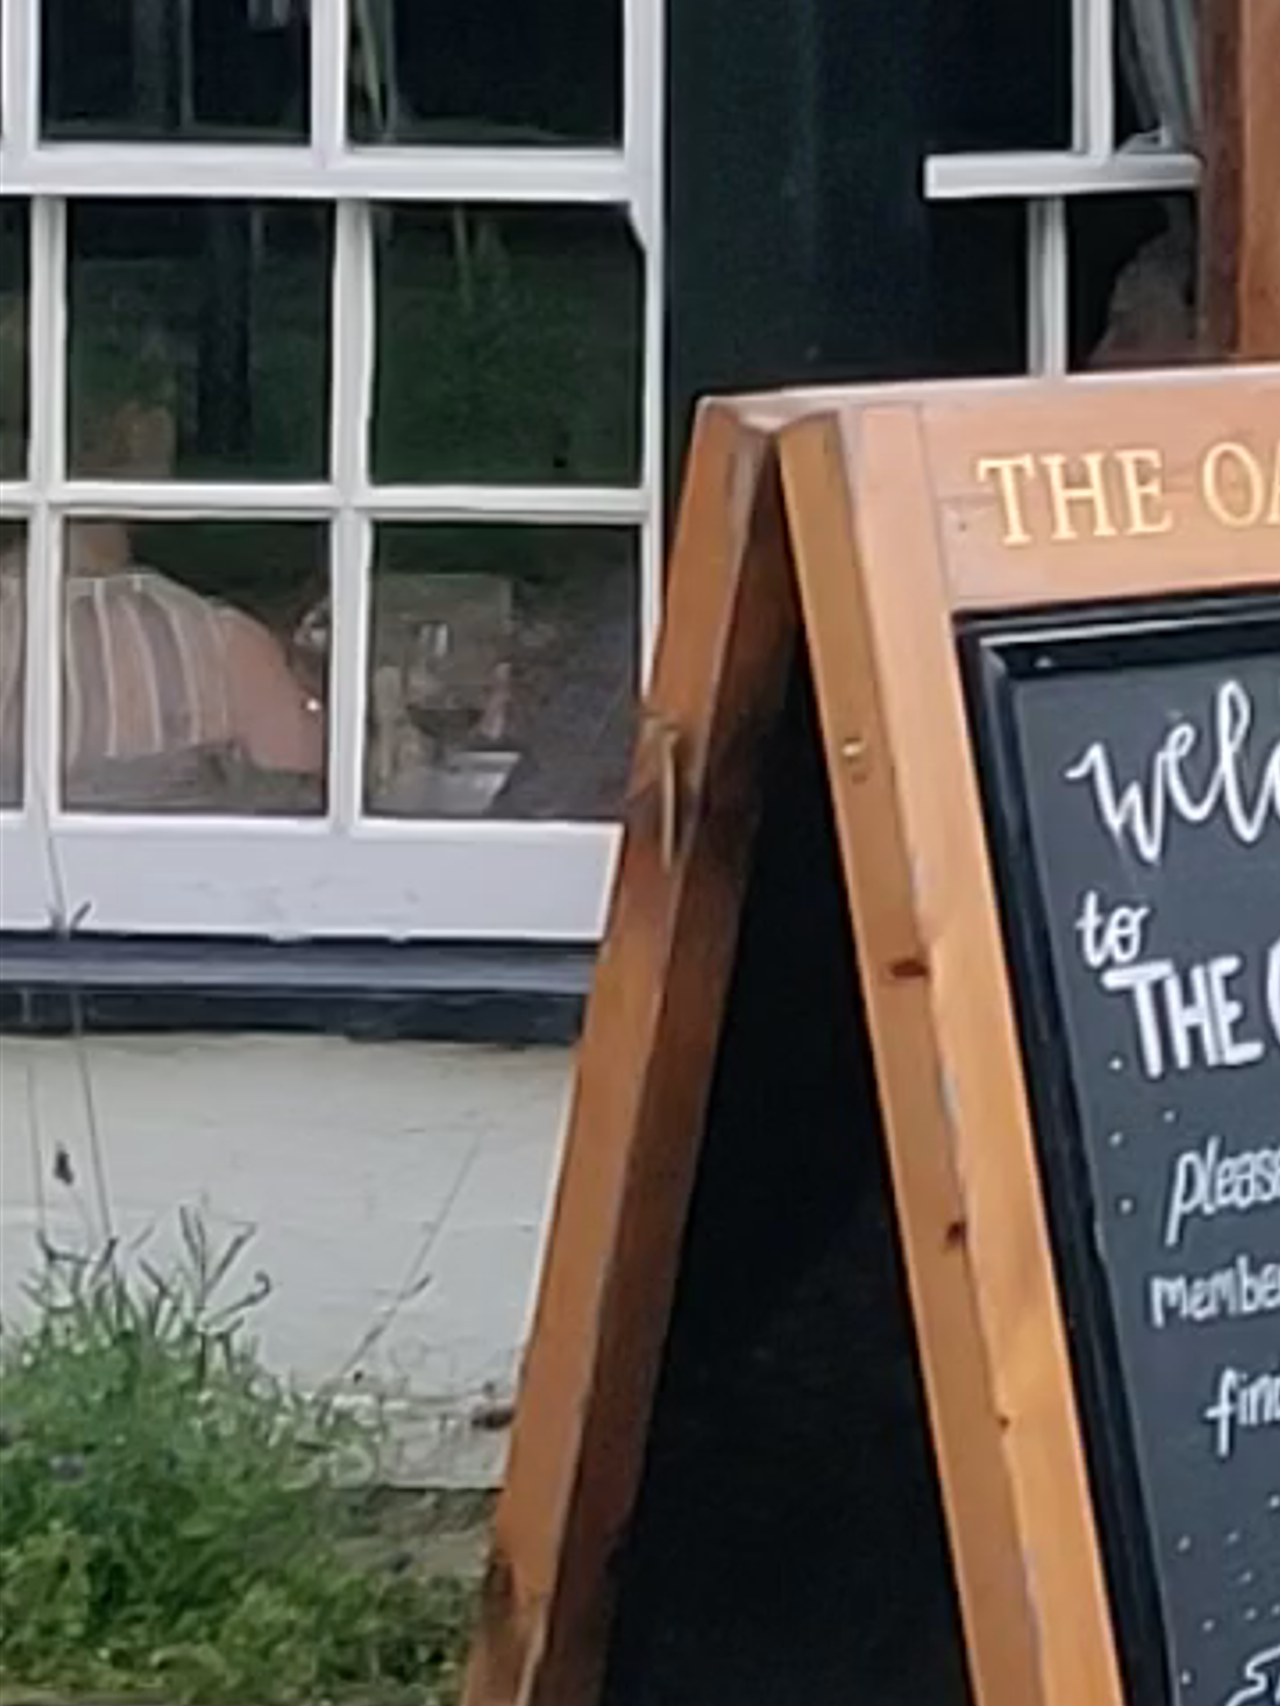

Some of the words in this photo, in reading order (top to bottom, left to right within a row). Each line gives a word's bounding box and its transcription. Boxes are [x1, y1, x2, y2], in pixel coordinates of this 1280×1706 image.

[978, 448, 1174, 545] THE
[1075, 891, 1150, 969] to
[1101, 956, 1264, 1079] THE
